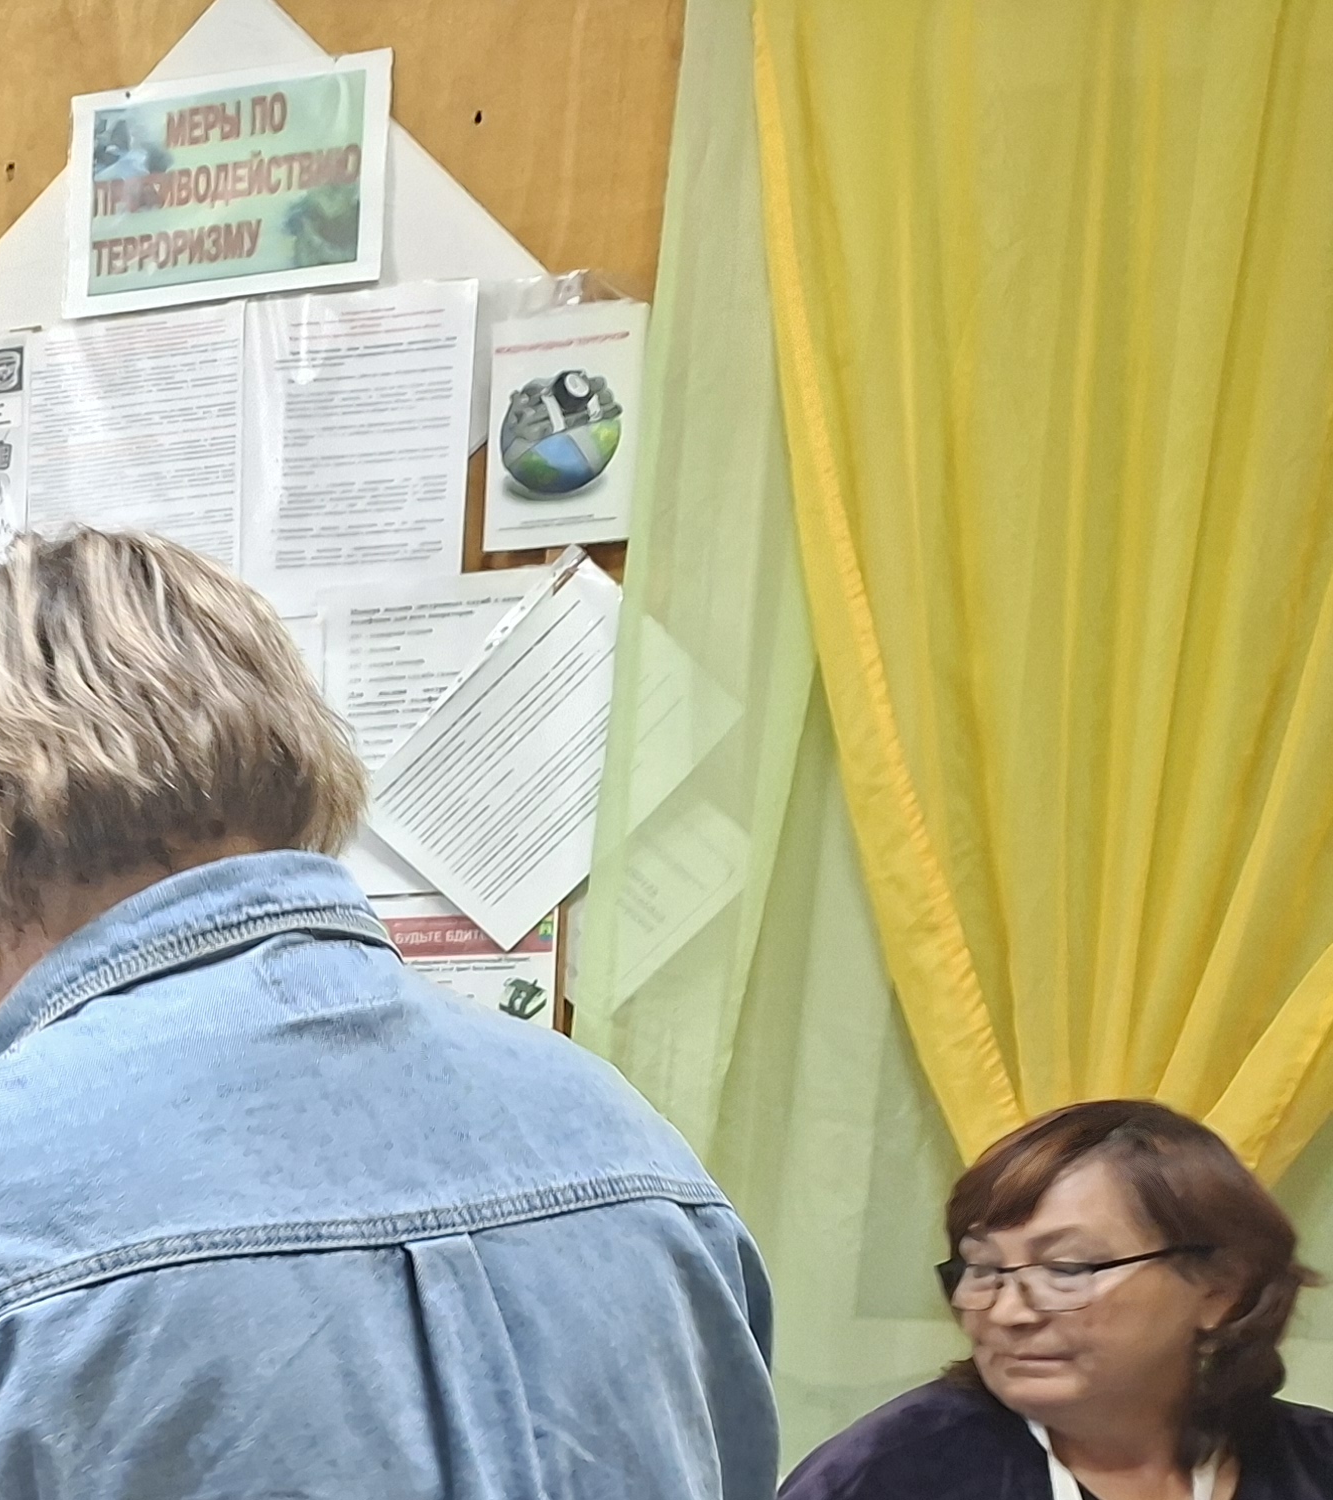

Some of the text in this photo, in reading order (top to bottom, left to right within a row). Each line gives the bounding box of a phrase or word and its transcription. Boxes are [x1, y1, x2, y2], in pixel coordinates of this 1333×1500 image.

[165, 91, 288, 149] МЕРЫ ПО
[93, 143, 362, 218] ПРИВОДЕЙСТВИЮ
[93, 218, 263, 277] ТЕРРОРИЗМУ
[395, 928, 484, 945] БУДЬТЕ БДИТ
